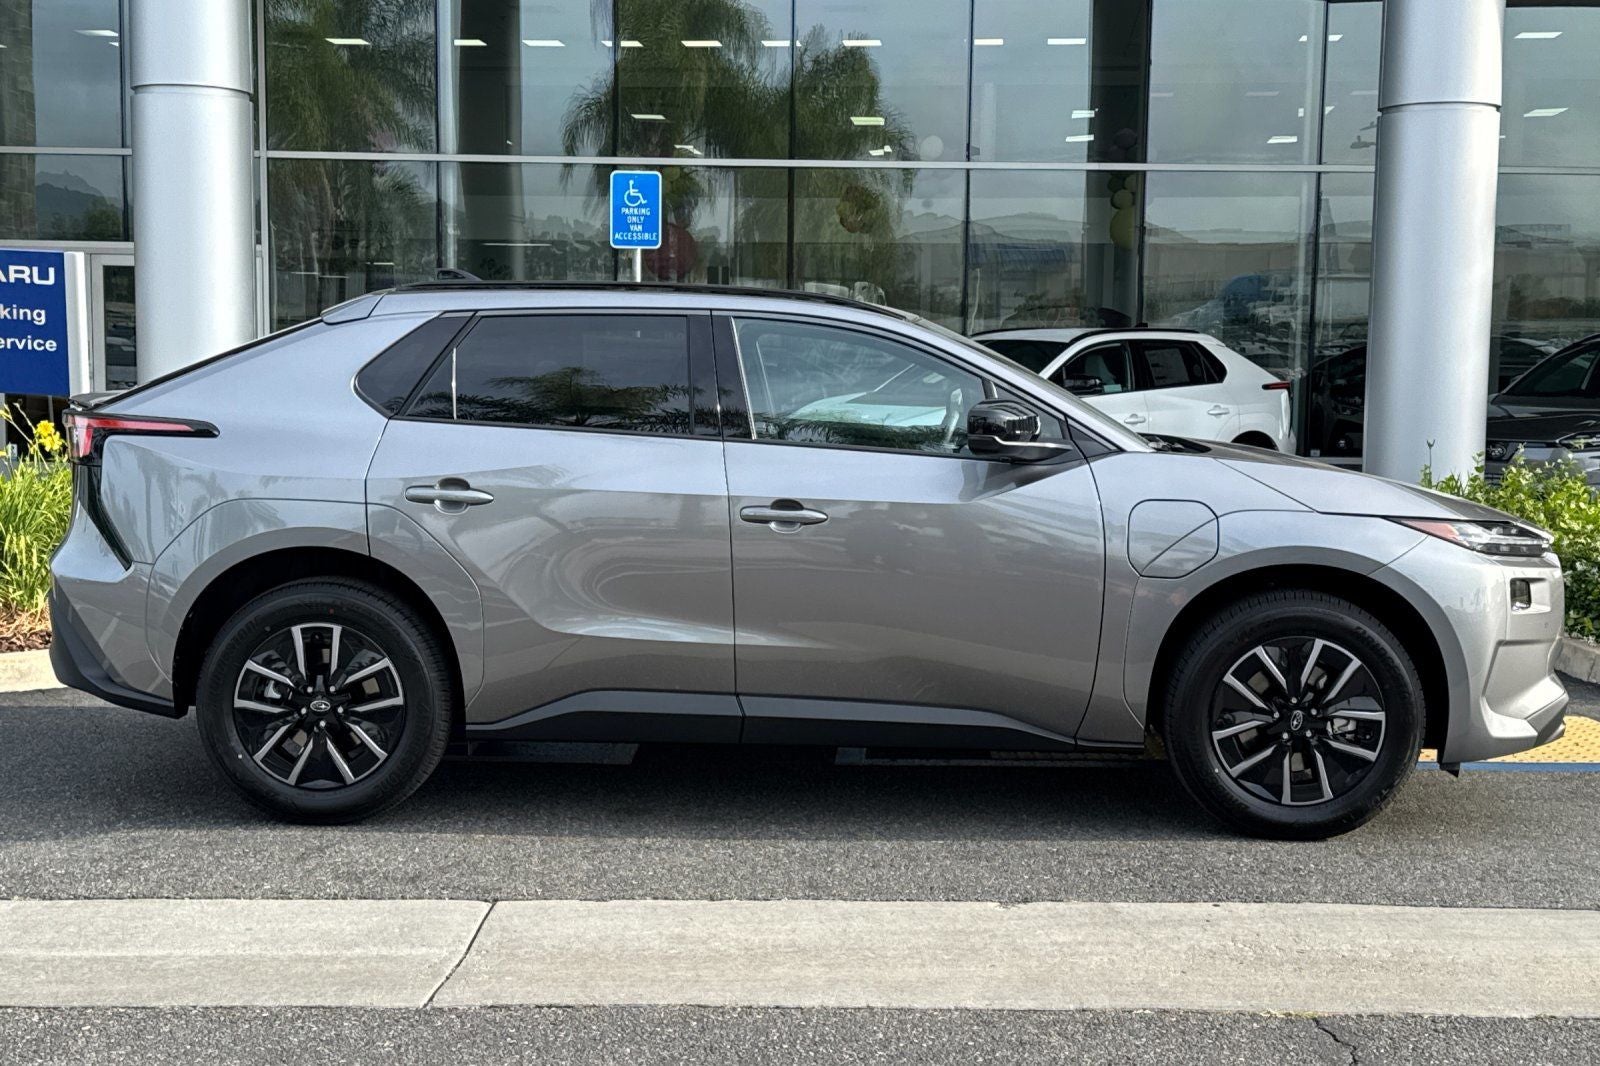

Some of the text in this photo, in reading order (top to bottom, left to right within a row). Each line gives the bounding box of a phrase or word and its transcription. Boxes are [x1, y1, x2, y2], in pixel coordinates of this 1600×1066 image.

[621, 207, 650, 216] PARKING
[629, 224, 643, 232] VAN
[614, 232, 657, 241] ACCESSIBLE
[0, 303, 46, 326] king
